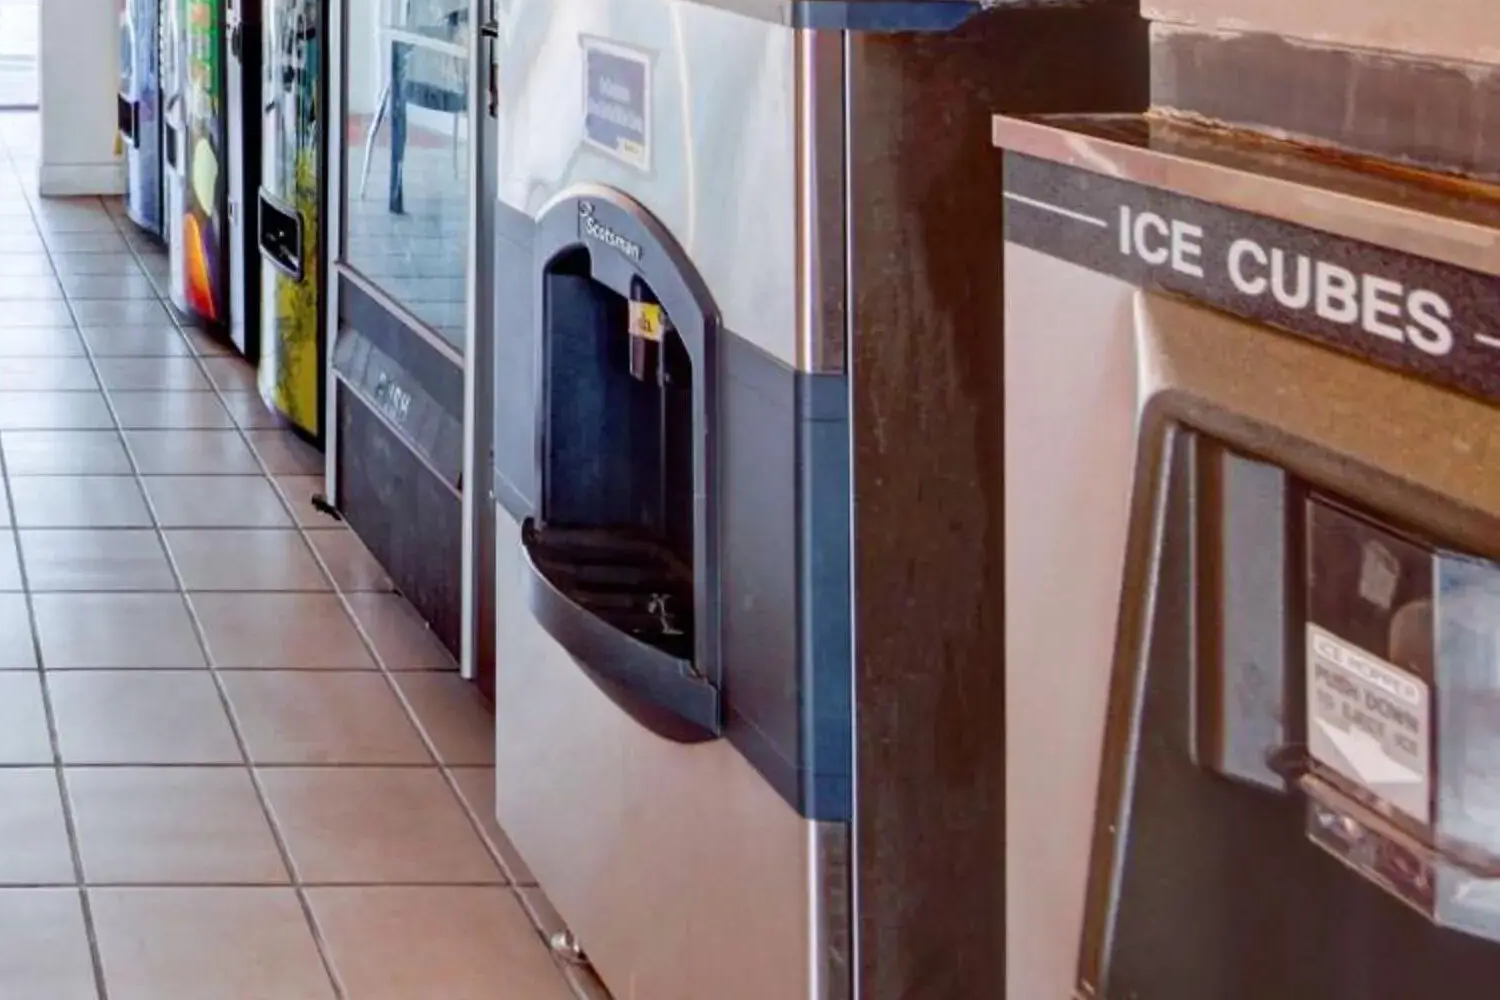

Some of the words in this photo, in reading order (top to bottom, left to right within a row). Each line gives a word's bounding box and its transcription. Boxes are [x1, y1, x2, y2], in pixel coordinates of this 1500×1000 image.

[585, 215, 641, 261] Scotsman
[1118, 205, 1205, 277] ICE
[1227, 238, 1454, 356] CUBES
[1363, 688, 1419, 736] DOWN
